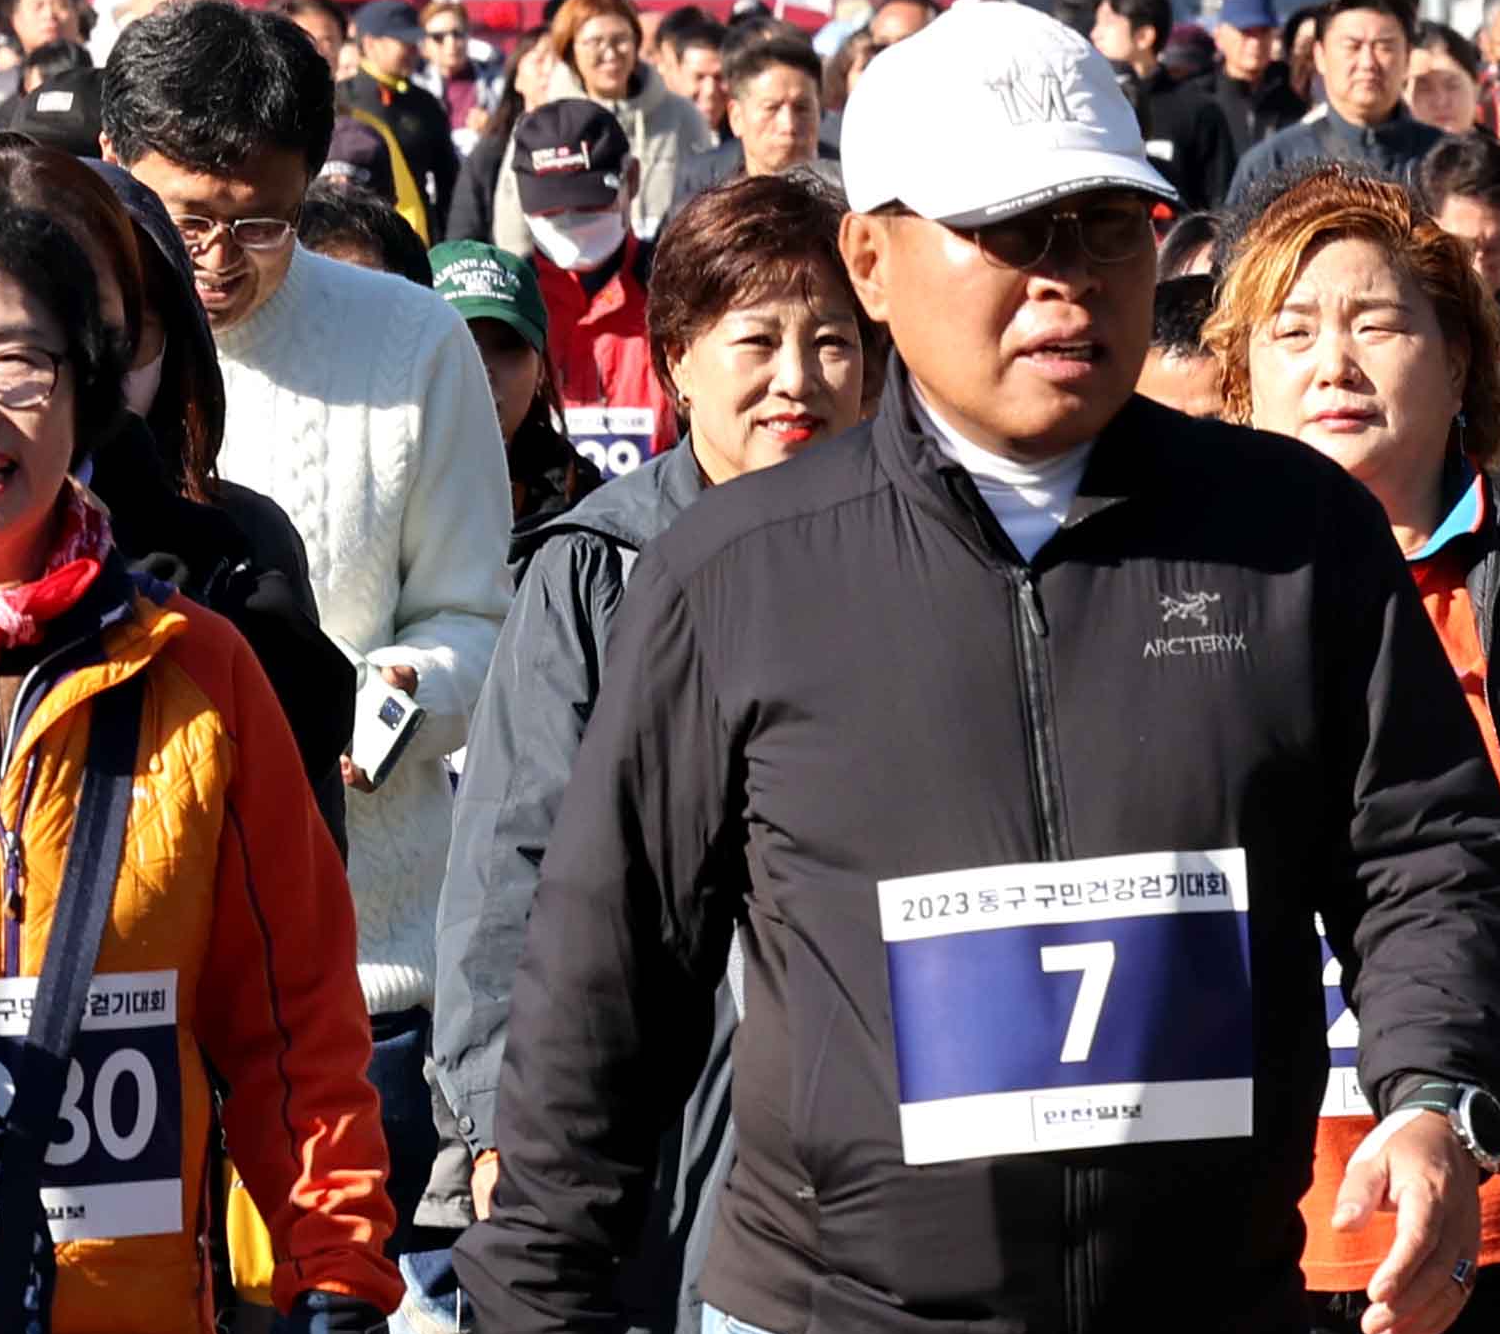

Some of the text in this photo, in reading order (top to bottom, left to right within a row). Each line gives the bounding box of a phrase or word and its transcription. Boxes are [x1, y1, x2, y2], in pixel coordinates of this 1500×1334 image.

[902, 872, 1228, 922] 2023 동구 구민건강걷기대회
[1040, 940, 1116, 1064] 7
